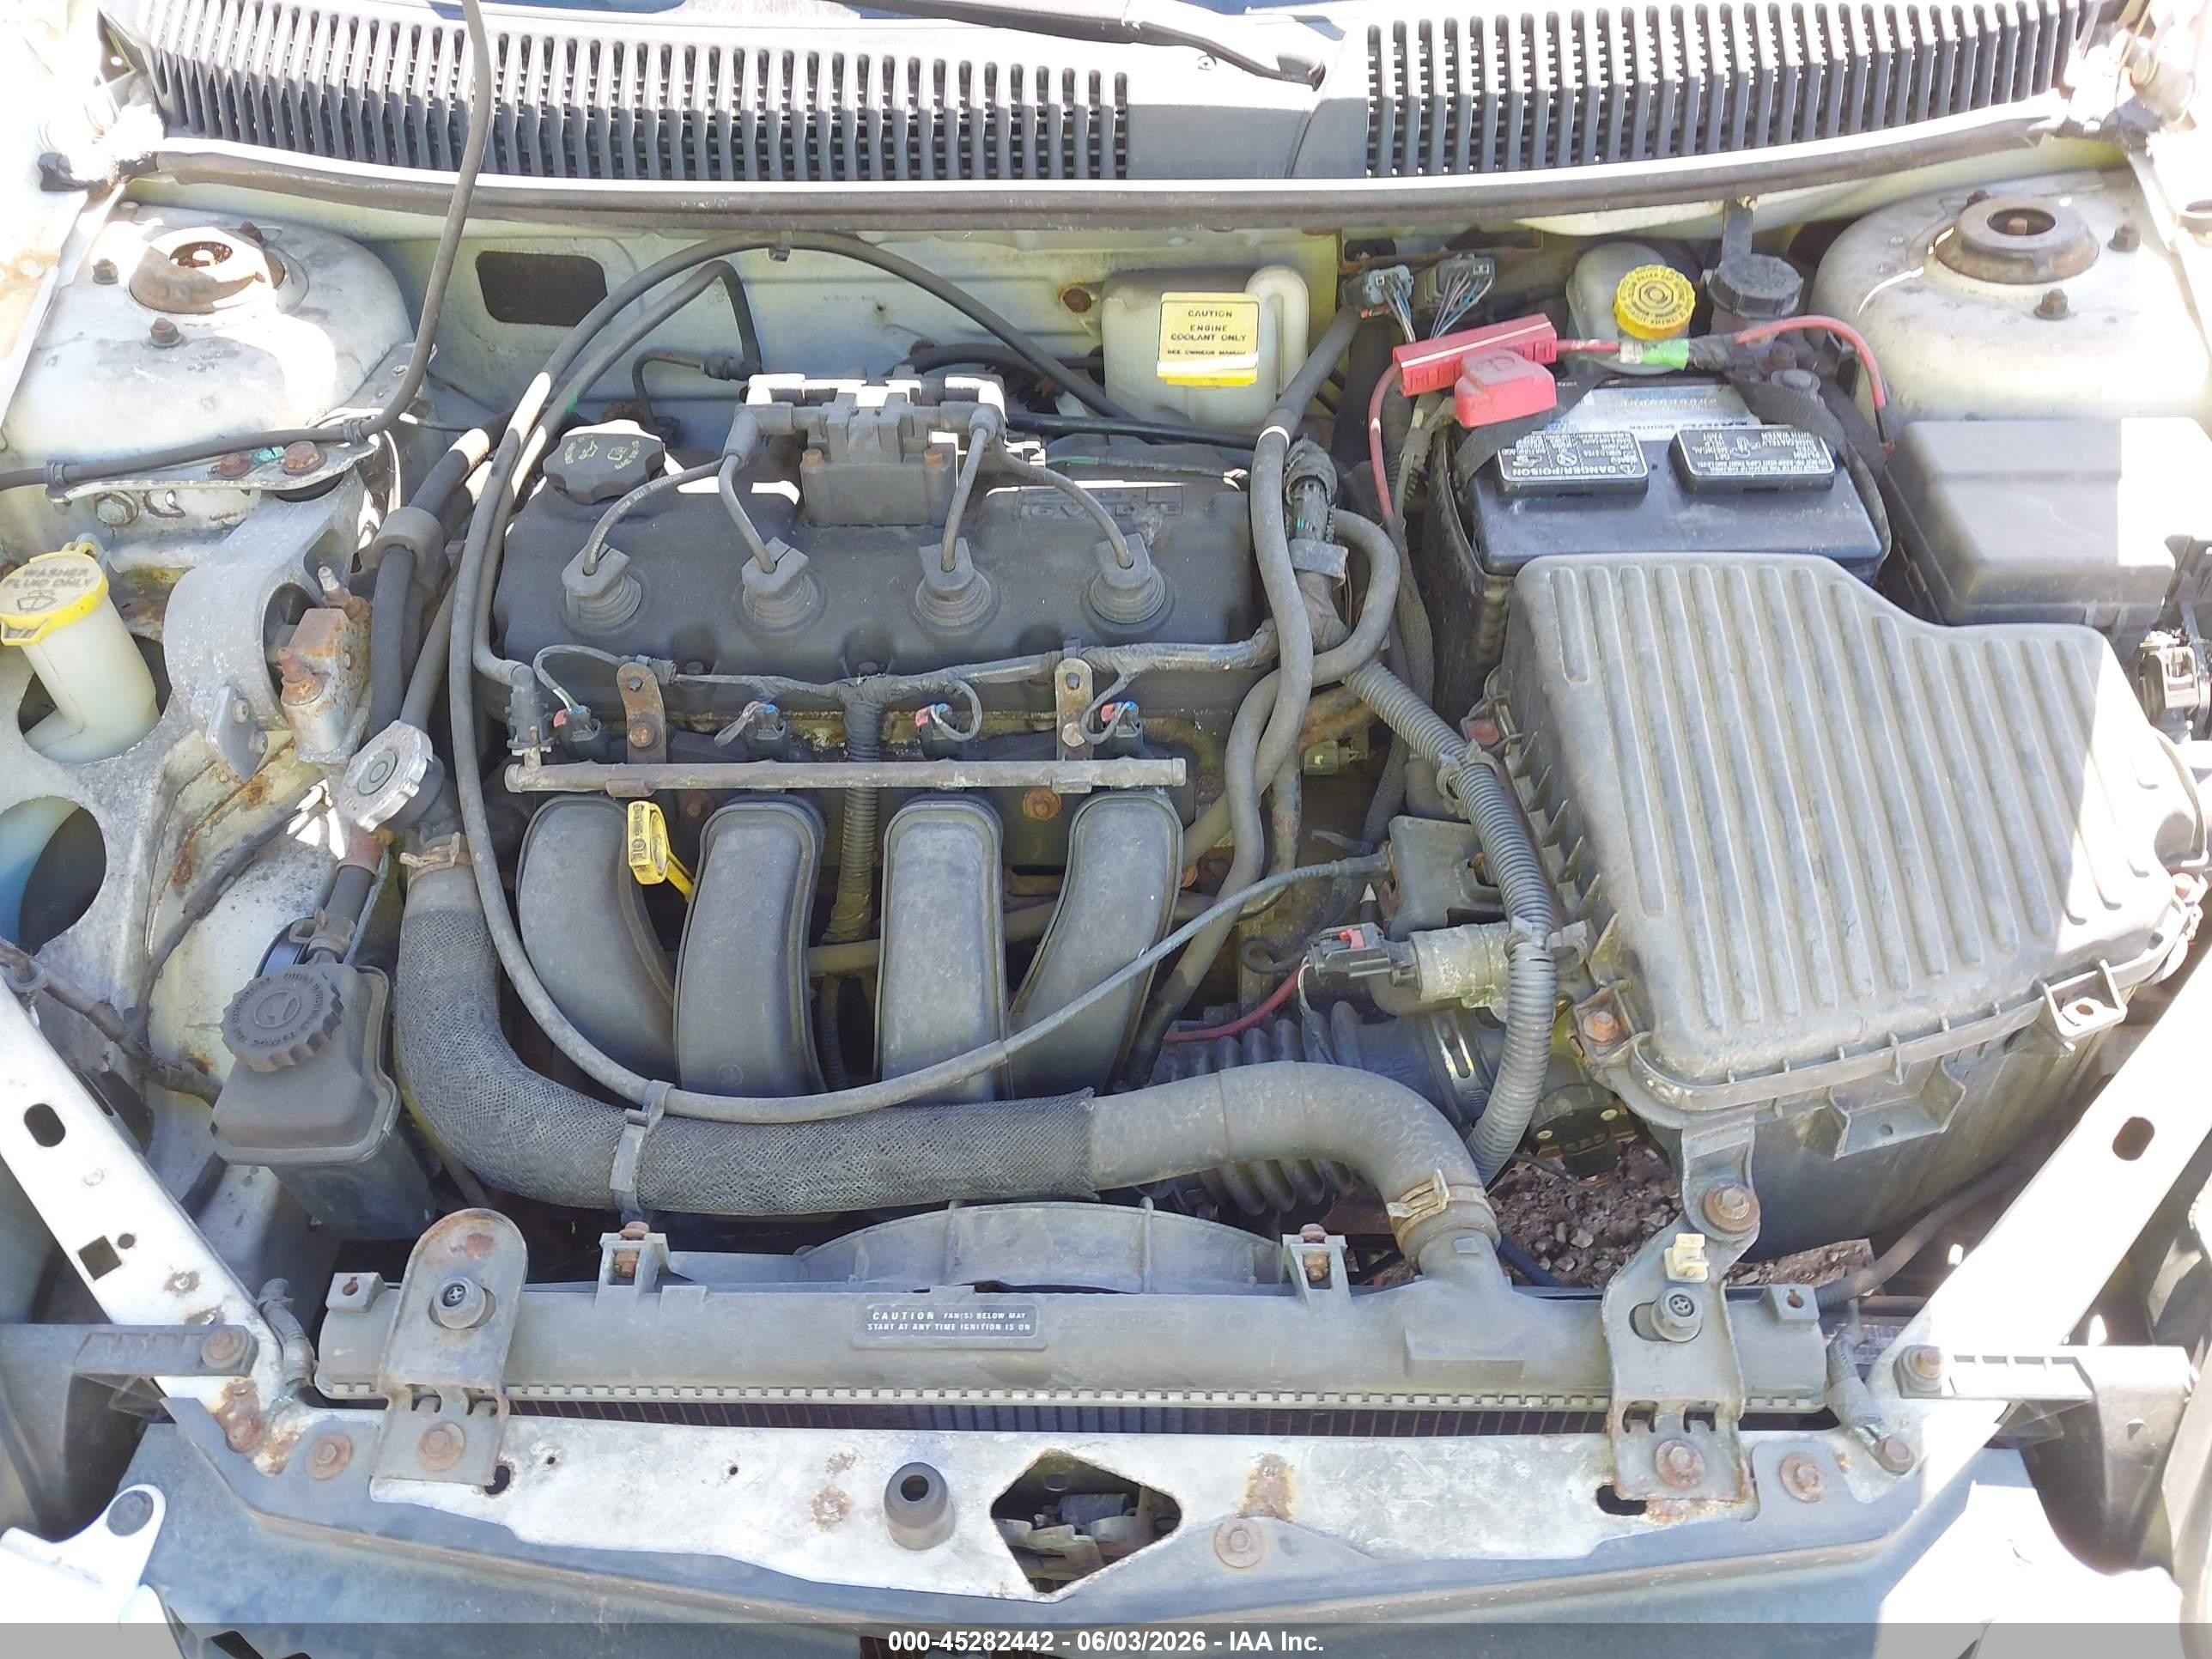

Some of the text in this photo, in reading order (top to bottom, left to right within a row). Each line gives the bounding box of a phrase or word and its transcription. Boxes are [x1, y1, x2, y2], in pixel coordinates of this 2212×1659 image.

[1188, 309, 1233, 319] CAUTION
[1189, 324, 1228, 332] ENGINE
[1170, 332, 1247, 342] COOLANT ONLY
[23, 568, 90, 577] WASHER
[52, 577, 93, 587] ONLY
[872, 1311, 935, 1321] CAUTION
[976, 1311, 1007, 1320] BELOW
[1008, 1311, 1027, 1320] MAY
[866, 1322, 1032, 1332] START AT ANY TIME IGNITION IS ON
